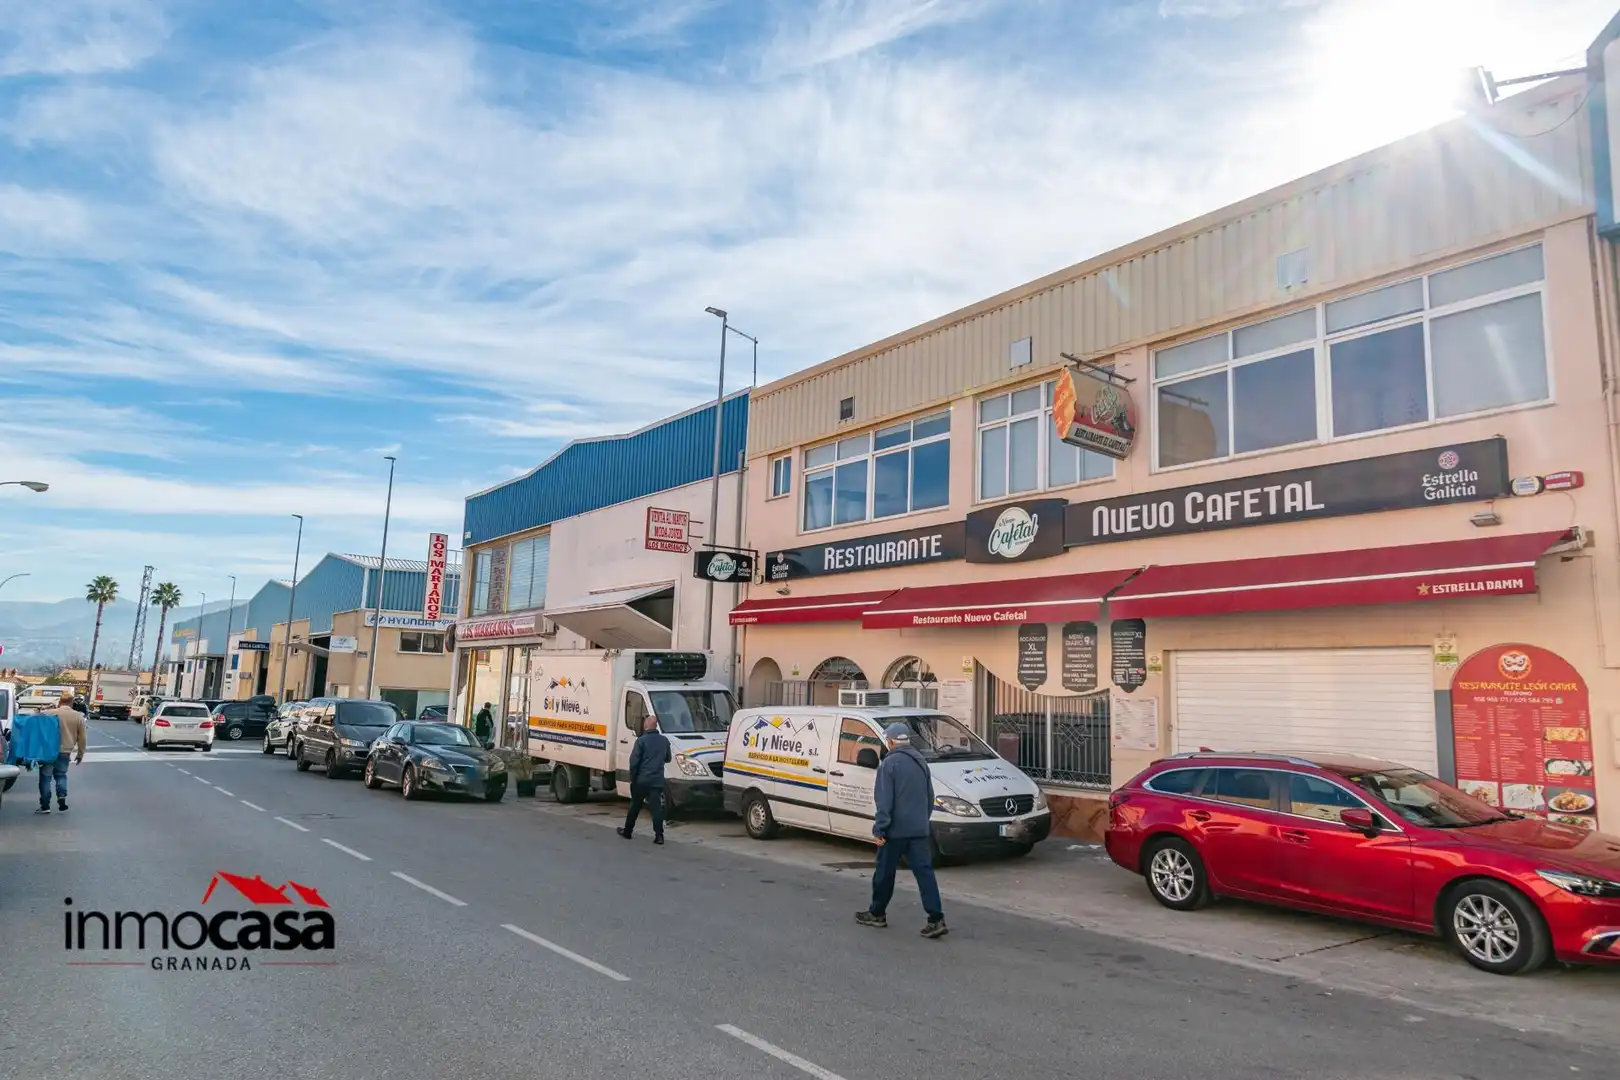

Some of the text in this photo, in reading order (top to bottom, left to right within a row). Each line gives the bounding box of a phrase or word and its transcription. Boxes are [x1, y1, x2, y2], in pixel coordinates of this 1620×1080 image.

[1421, 469, 1478, 486] Estrella
[1424, 482, 1476, 500] Galicia
[1092, 480, 1325, 536] NUEVO CAFETAL
[990, 515, 1036, 553] Cafetal
[432, 536, 444, 558] LOS
[649, 541, 659, 549] LOS
[824, 534, 942, 570] RESTAURANTE
[708, 560, 736, 576] Cafetal
[772, 564, 788, 572] Estrella
[1432, 578, 1524, 594] ESTRELLA DAMM
[388, 616, 435, 627] HYUNDAI
[912, 610, 1027, 624] Restaurante Nuevo Cafetal
[1028, 642, 1037, 650] XL
[544, 698, 554, 710] Sol
[556, 701, 560, 713] y
[743, 732, 759, 748] Sol
[762, 737, 768, 752] y
[771, 735, 804, 756] Nieve,
[748, 752, 769, 761] SERVICIO
